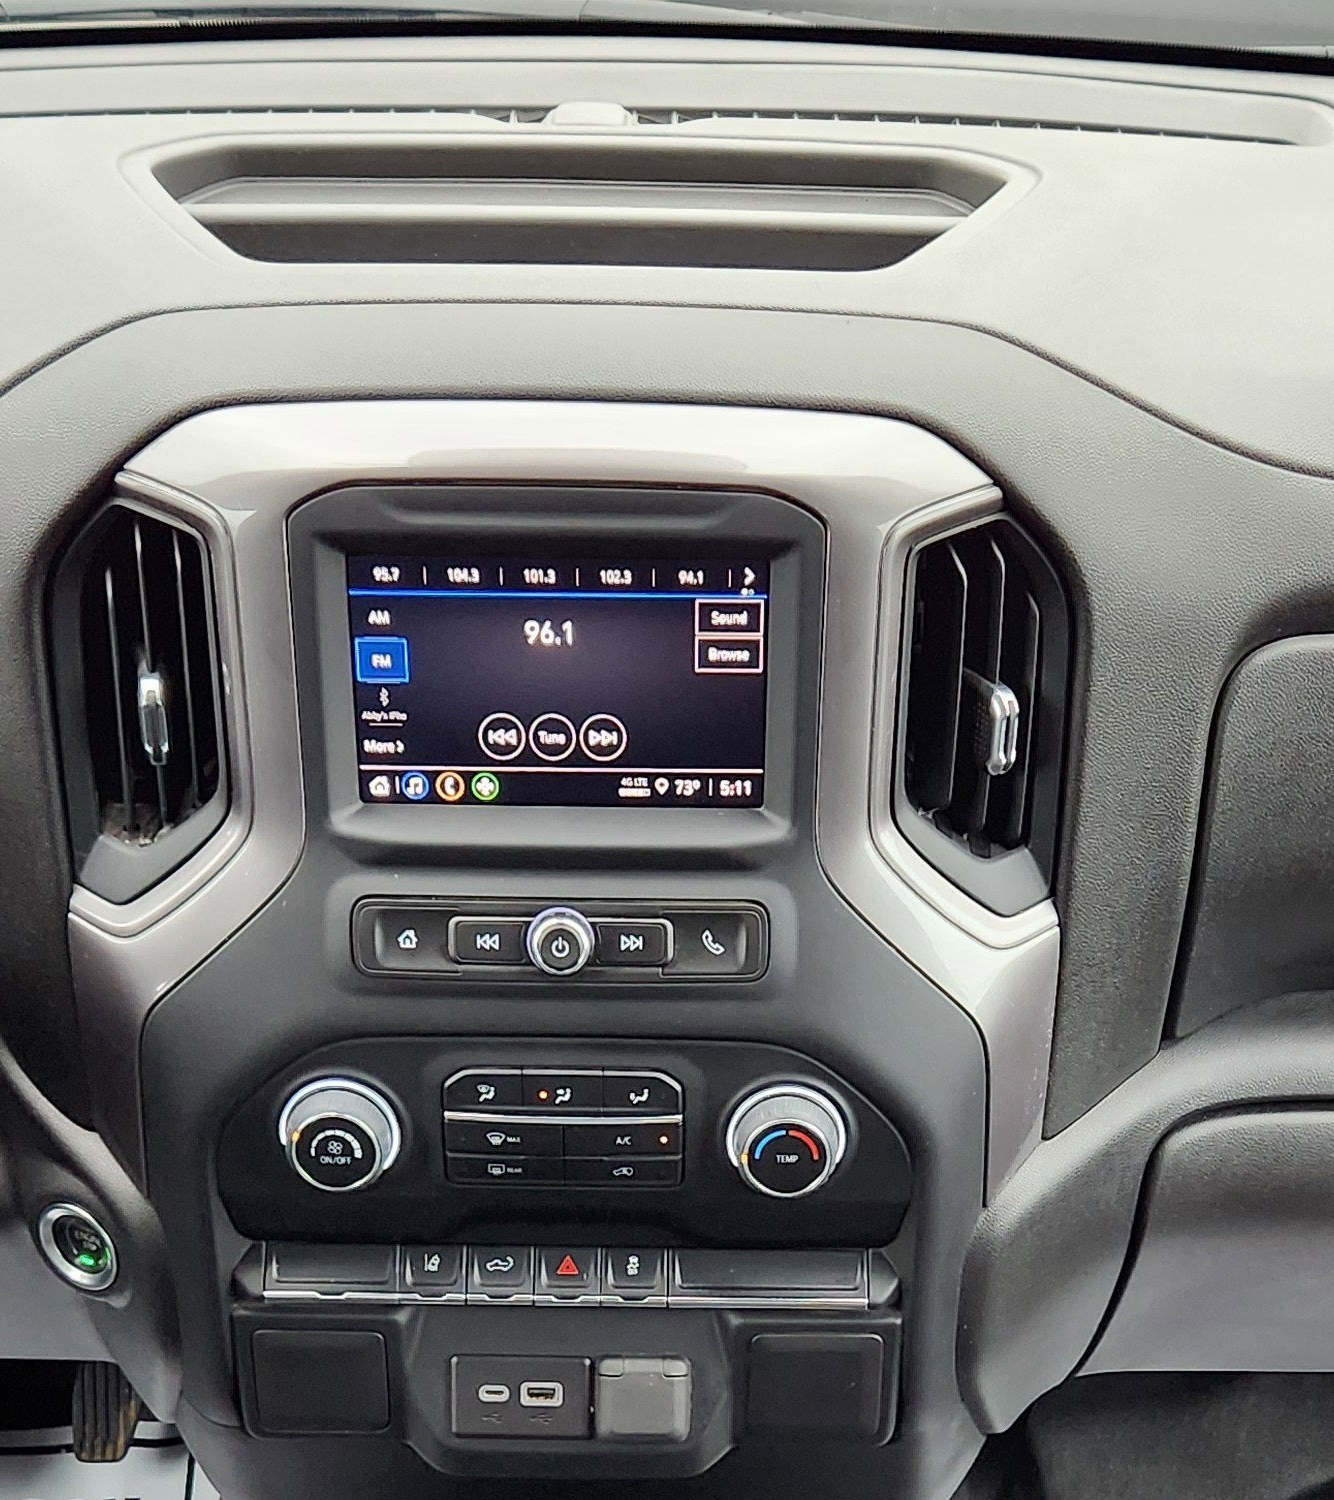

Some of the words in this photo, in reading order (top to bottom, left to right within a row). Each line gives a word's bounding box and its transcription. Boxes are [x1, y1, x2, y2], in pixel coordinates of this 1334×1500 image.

[523, 568, 556, 584] 101.3
[367, 609, 391, 626] AM
[710, 610, 748, 626] Sound
[523, 619, 574, 646] 96.1
[370, 653, 392, 669] FM
[707, 646, 750, 663] Browse
[537, 730, 566, 745] Tune
[363, 738, 395, 754] More
[634, 777, 649, 787] LTE
[719, 779, 752, 797] 5:11
[616, 1136, 631, 1146] A/C
[319, 1156, 351, 1165] ON/OFF
[776, 1154, 799, 1164] TEMP
